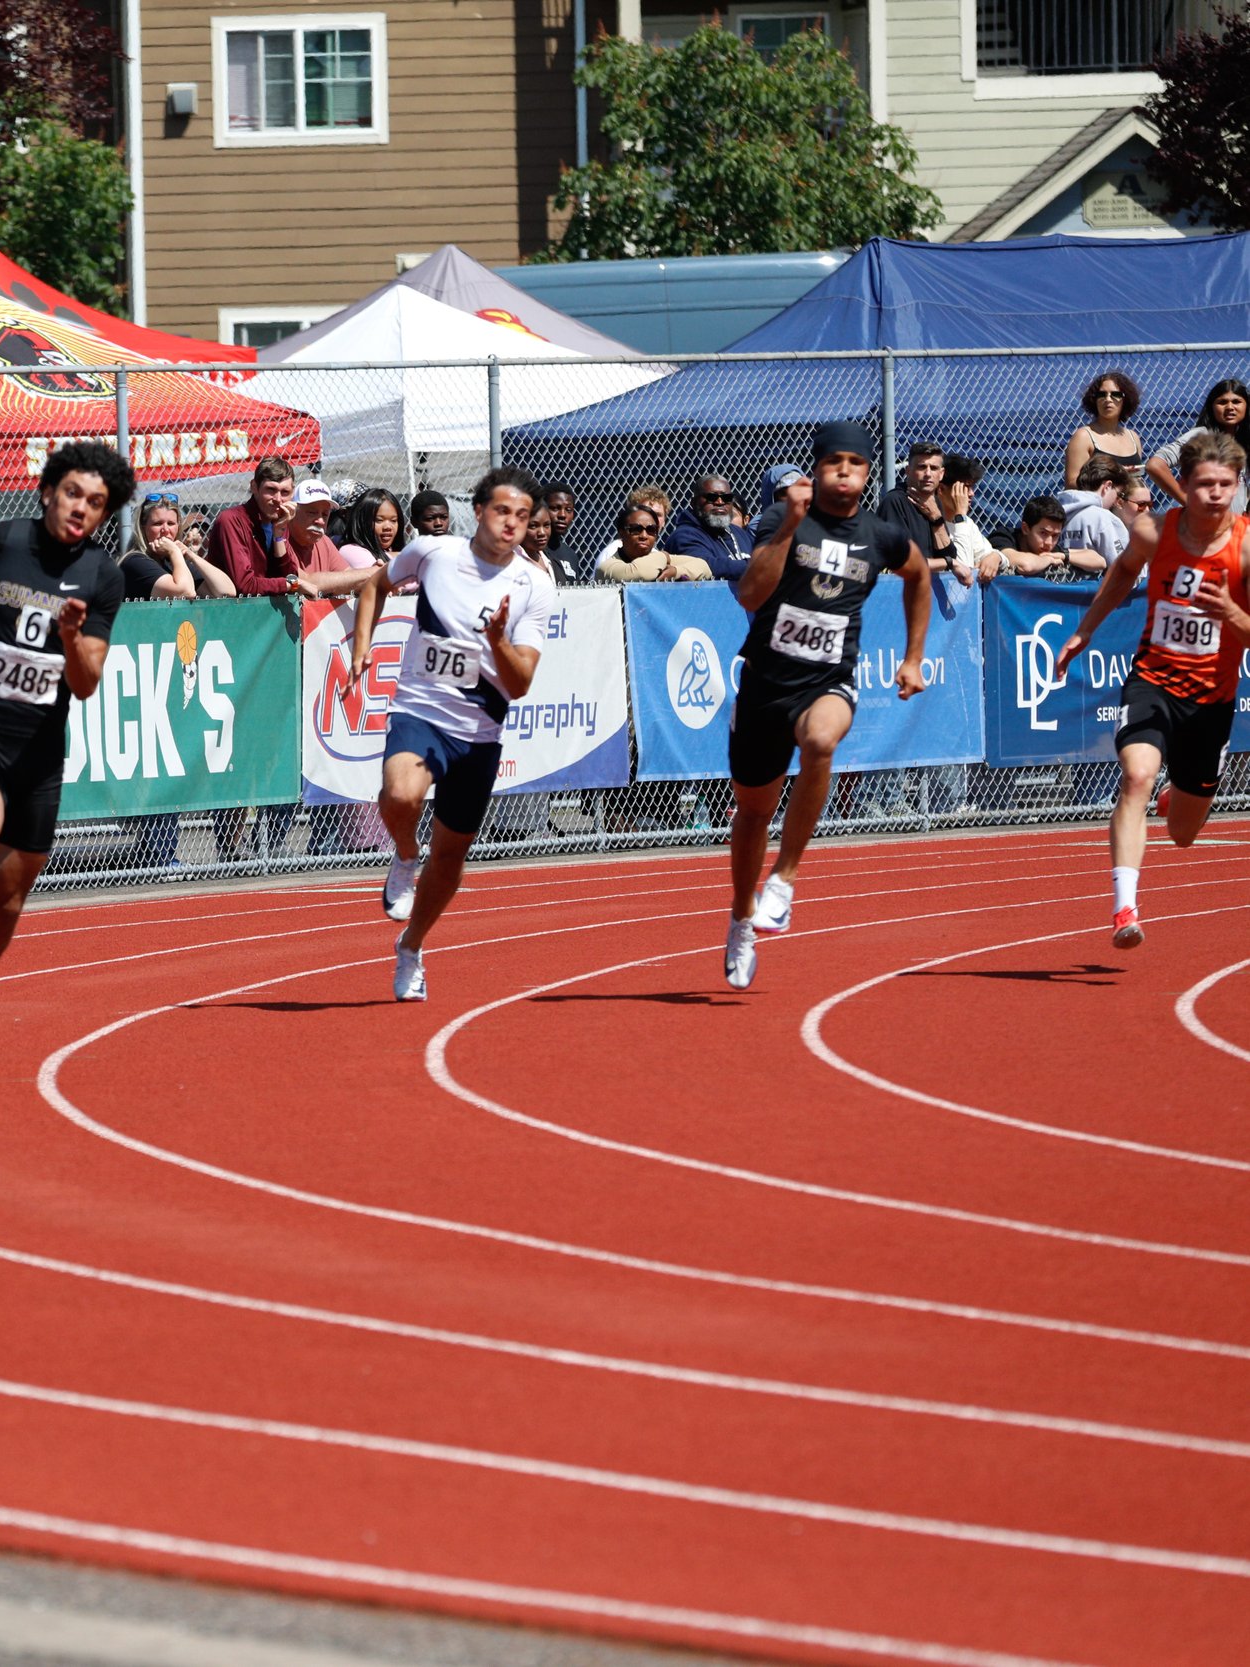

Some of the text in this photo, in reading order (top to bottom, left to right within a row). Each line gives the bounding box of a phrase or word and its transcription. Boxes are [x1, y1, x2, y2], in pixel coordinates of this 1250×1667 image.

[826, 545, 840, 572] 4
[1176, 569, 1196, 598] 3
[25, 611, 43, 642] 6
[473, 606, 495, 633] 5
[1161, 615, 1214, 646] 1399
[779, 620, 837, 654] 2488
[425, 646, 467, 678] 976
